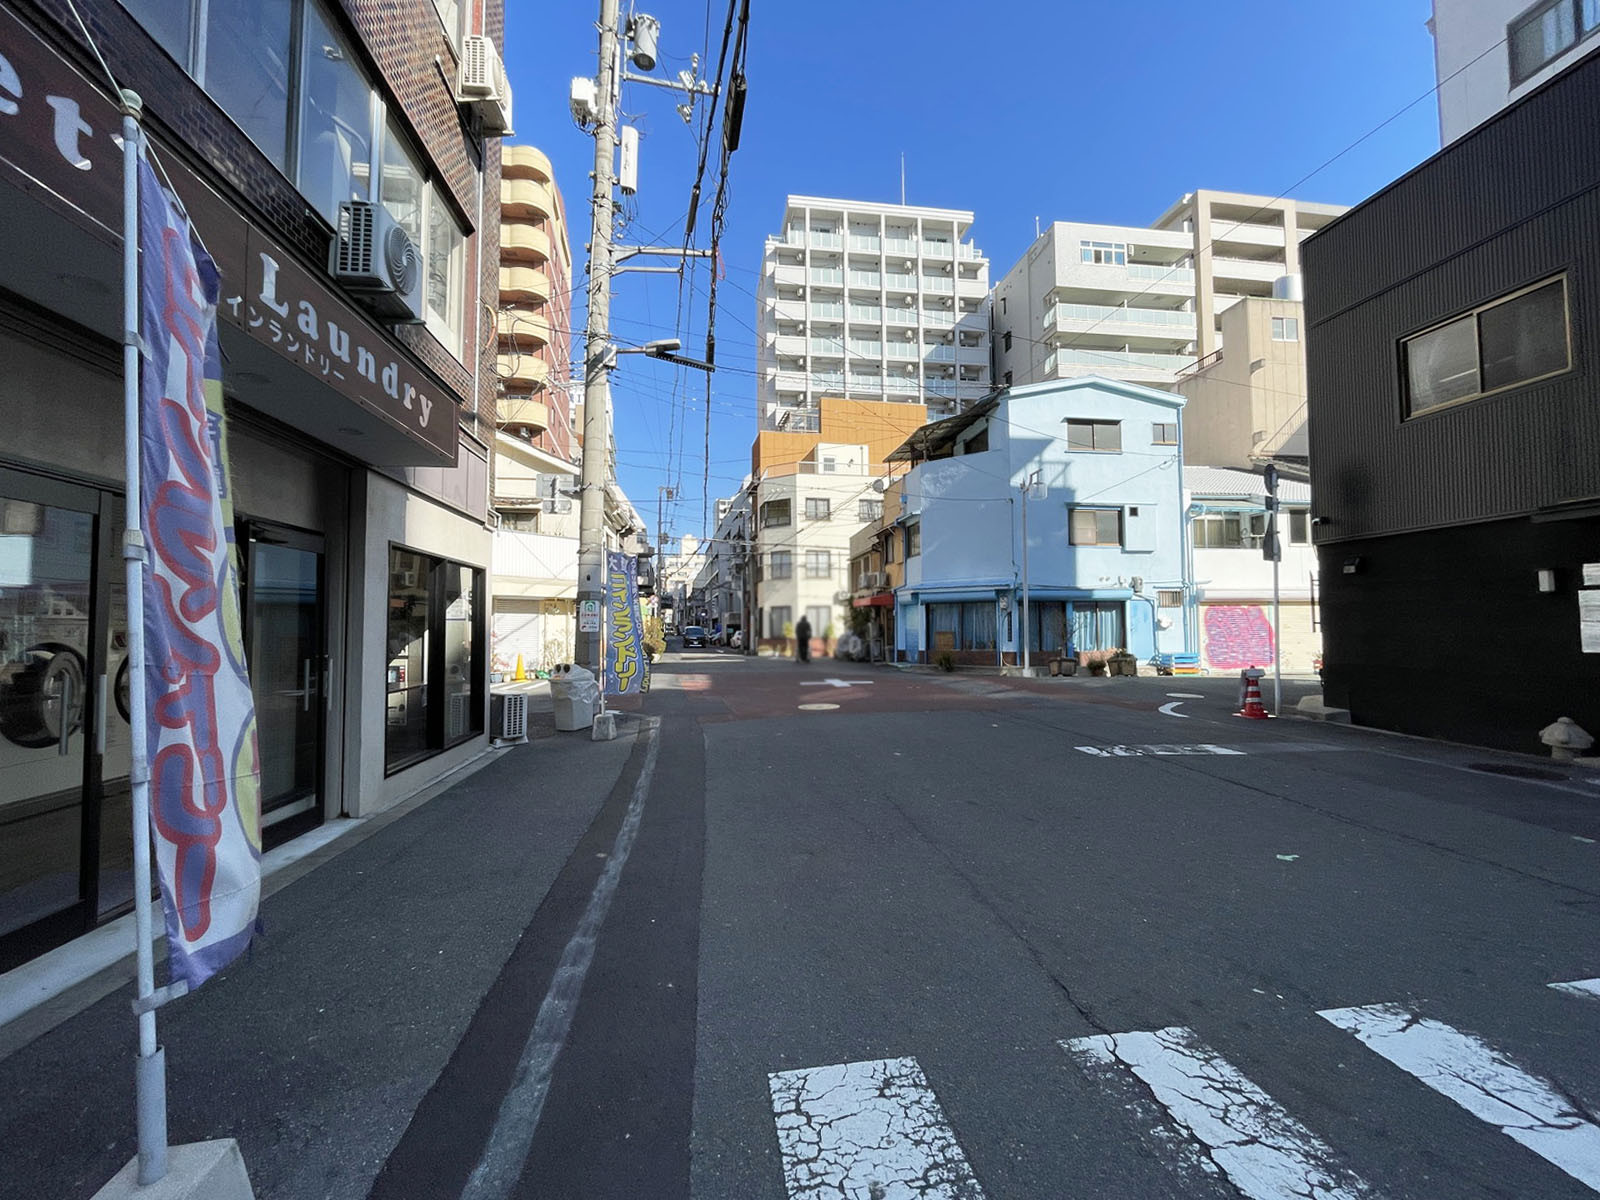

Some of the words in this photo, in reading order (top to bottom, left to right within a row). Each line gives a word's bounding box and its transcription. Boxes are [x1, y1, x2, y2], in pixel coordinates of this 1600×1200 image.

[259, 252, 433, 428] Laundry
[611, 573, 637, 692] コインランドリー
